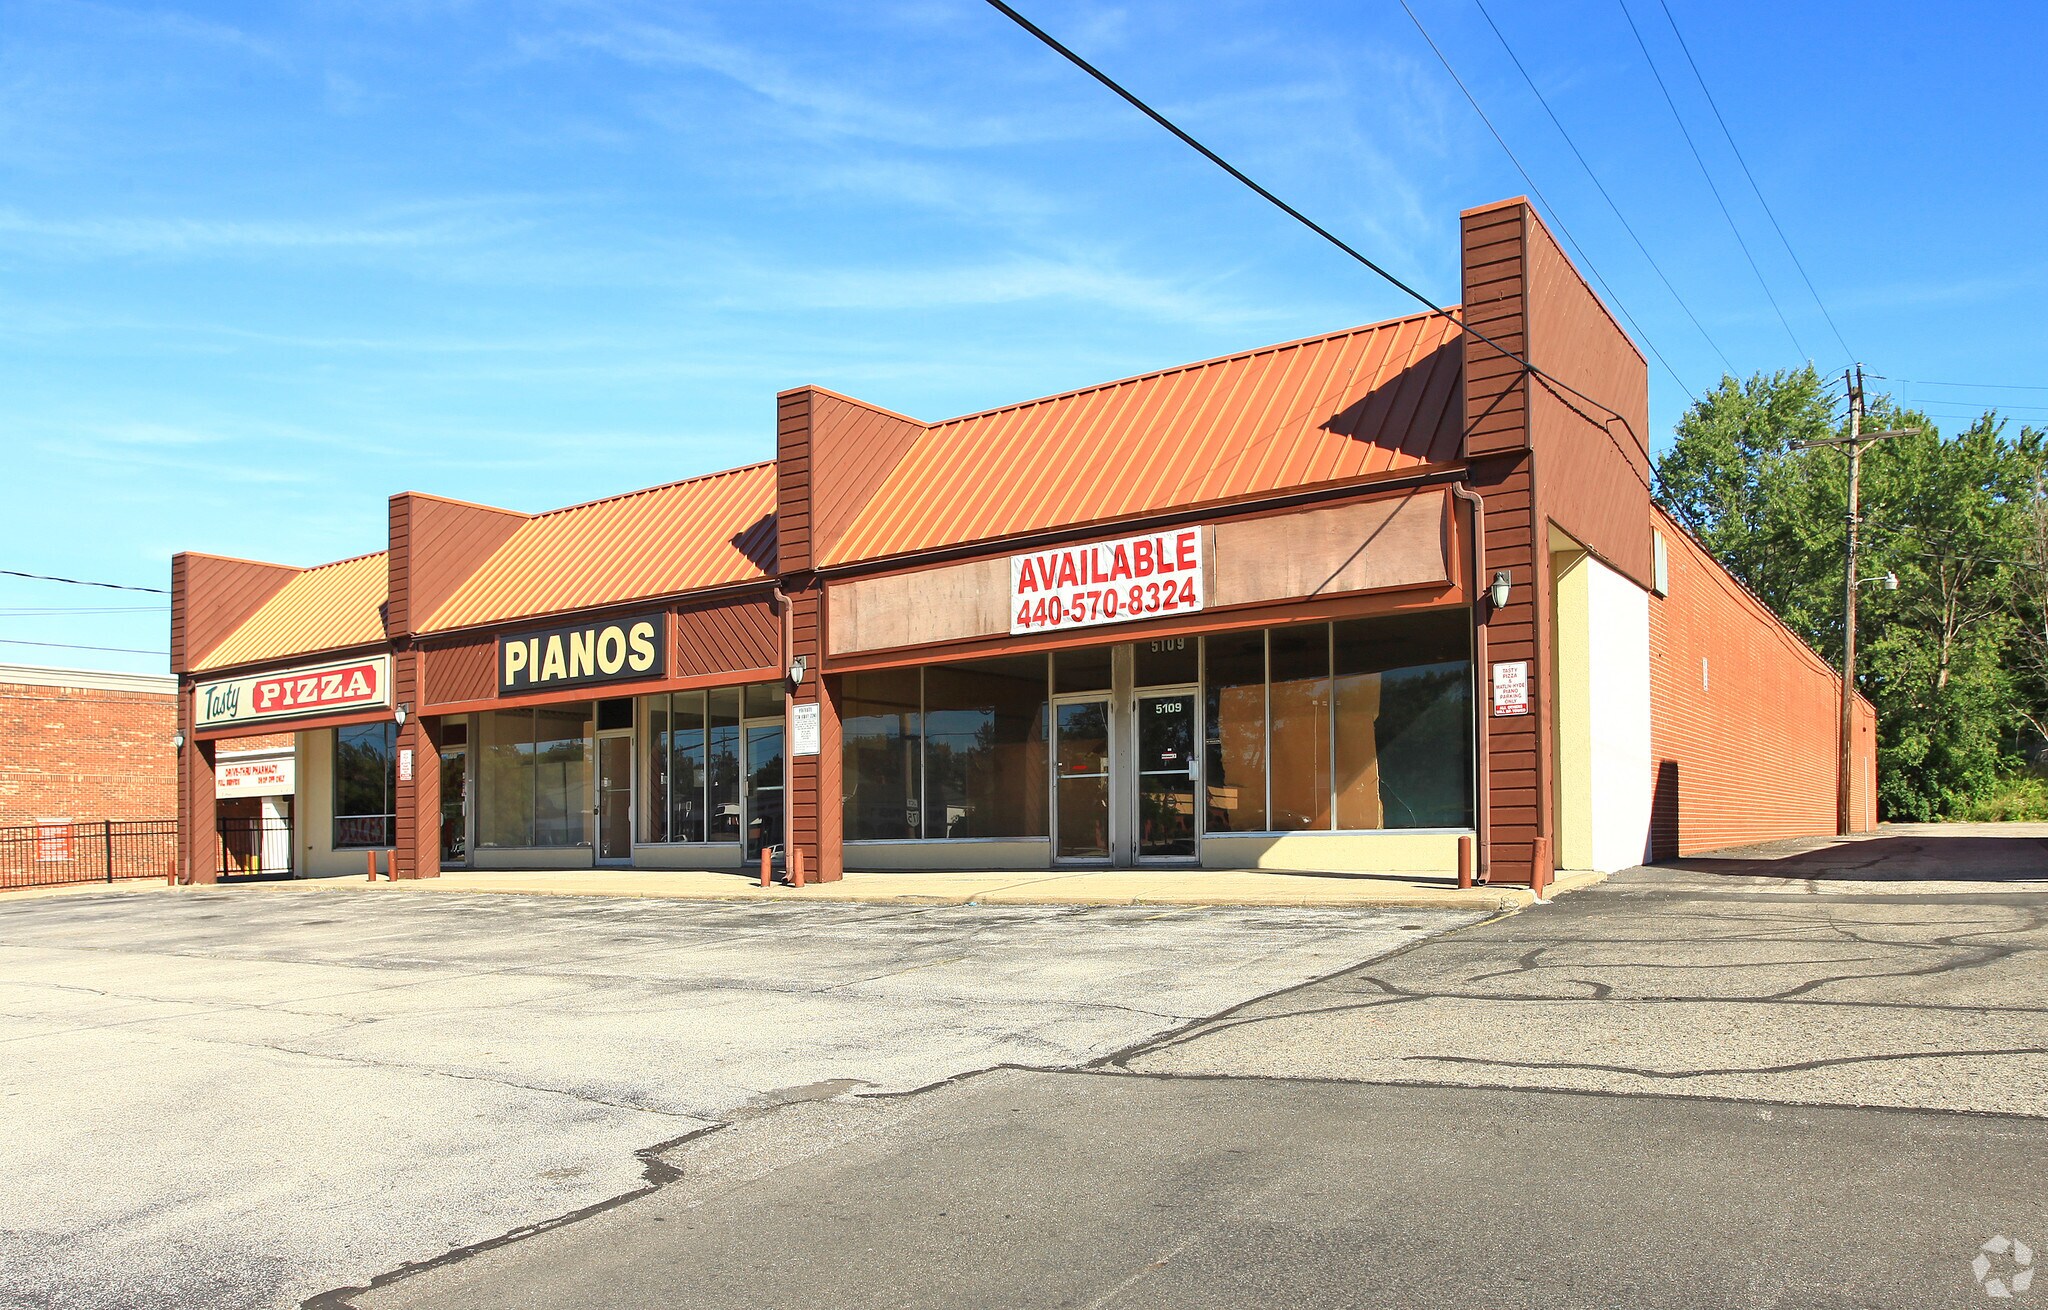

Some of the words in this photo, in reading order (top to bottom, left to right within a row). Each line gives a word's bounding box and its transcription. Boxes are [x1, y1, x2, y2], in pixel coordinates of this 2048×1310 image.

[1018, 532, 1196, 594] AVAILABLE
[1017, 577, 1196, 628] 440-570-8324
[505, 622, 655, 686] PIANOS
[1151, 638, 1184, 652] 5109
[205, 683, 240, 720] Tasty
[260, 671, 371, 708] PIZZA
[1156, 702, 1182, 714] 5109
[252, 764, 278, 775] PHARMACY
